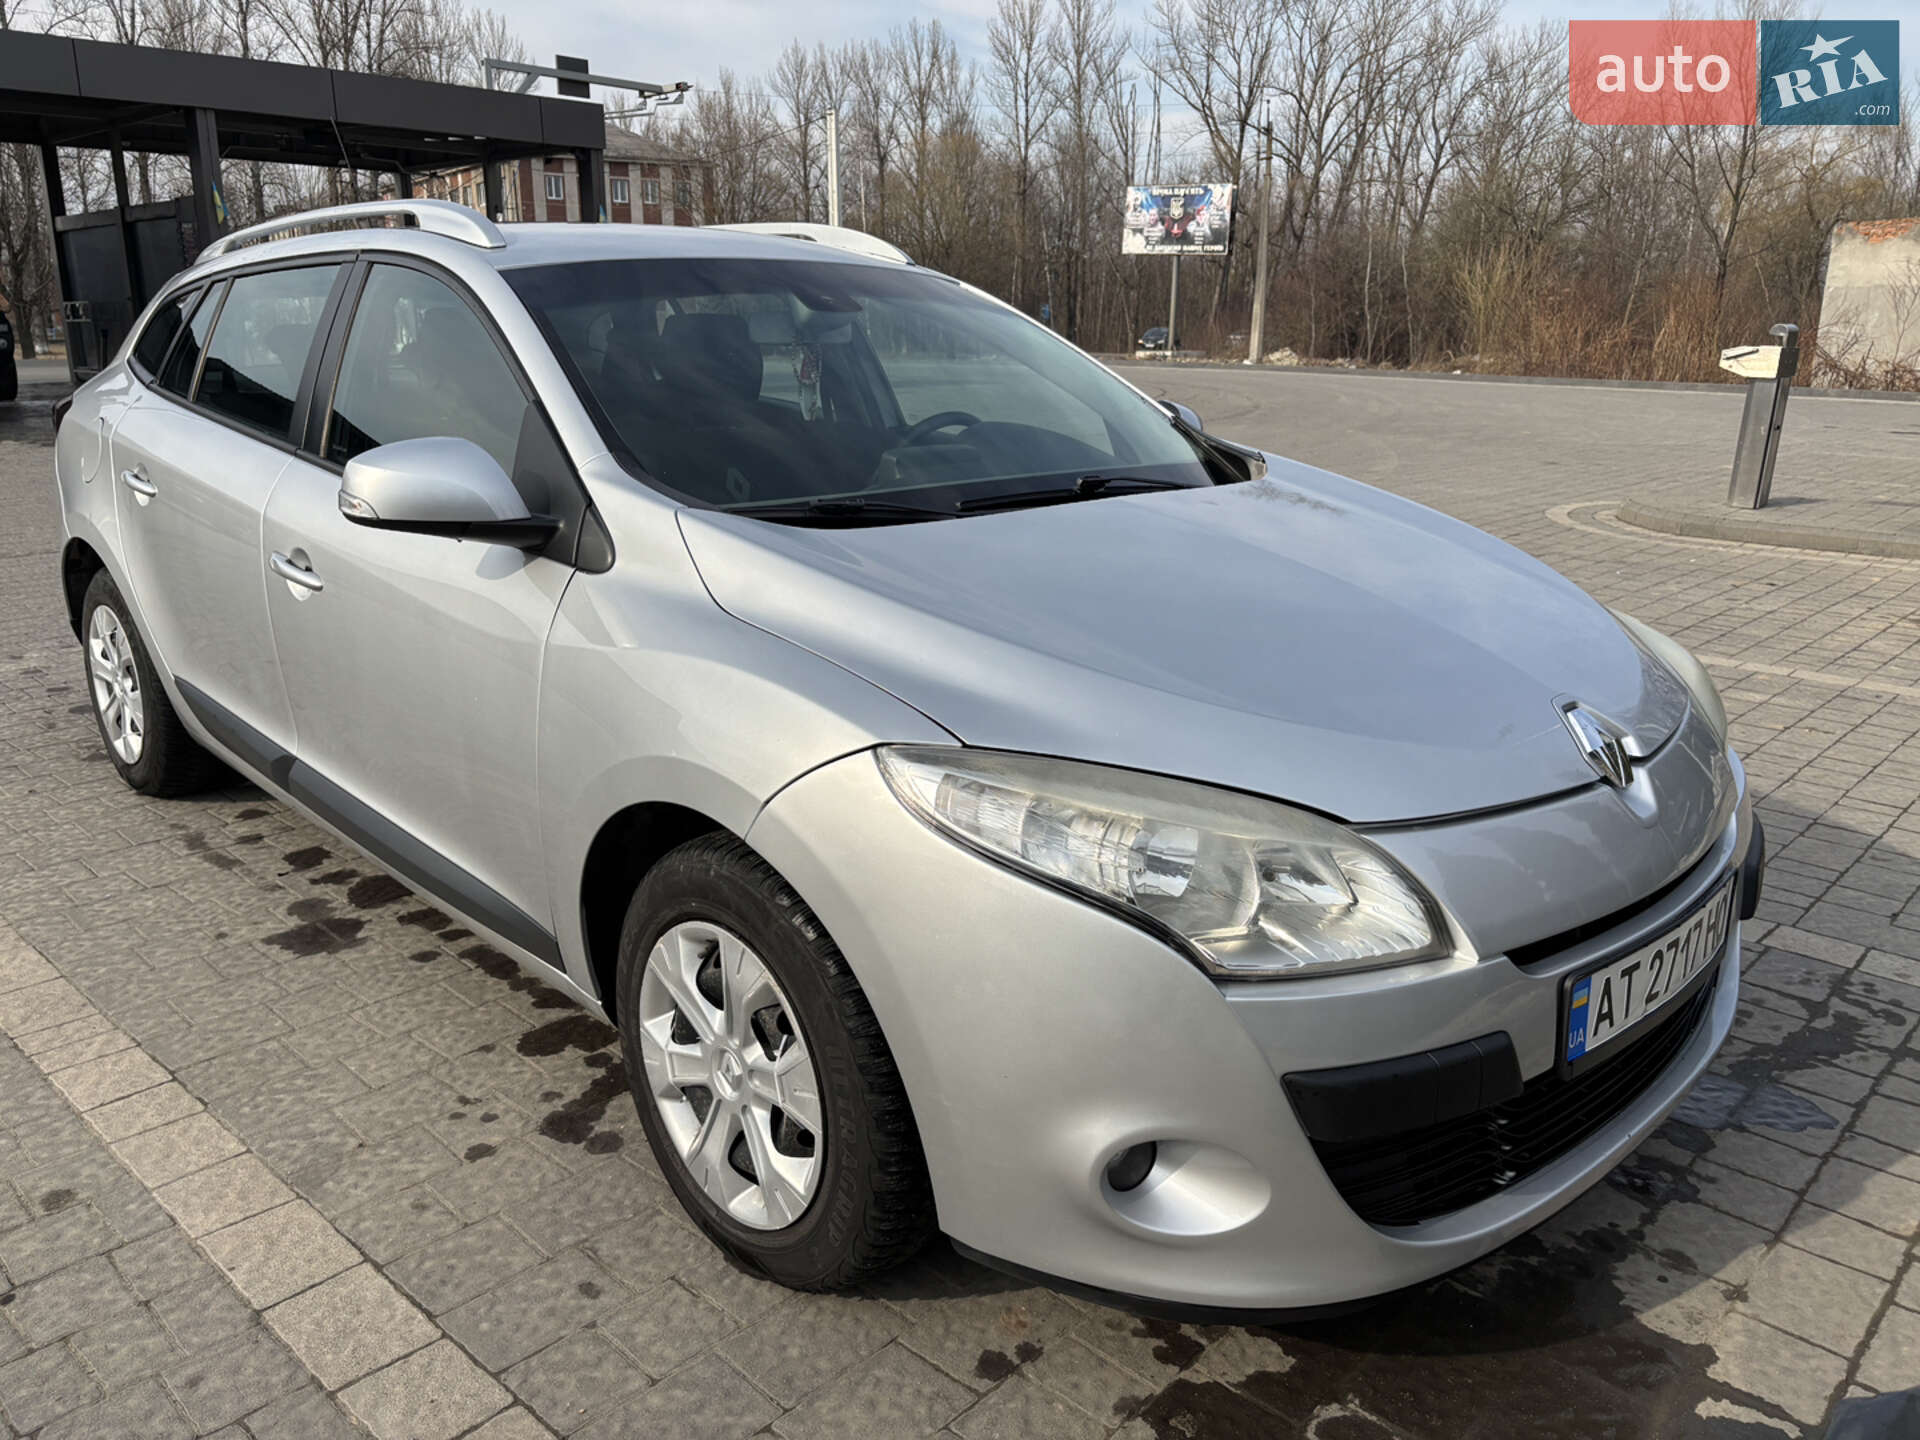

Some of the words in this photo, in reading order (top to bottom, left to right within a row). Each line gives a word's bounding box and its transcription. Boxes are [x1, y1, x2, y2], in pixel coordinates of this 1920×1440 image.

[1592, 960, 1641, 1038] AT
[1644, 919, 1702, 1006] 2717
[1568, 1027, 1585, 1049] UA
